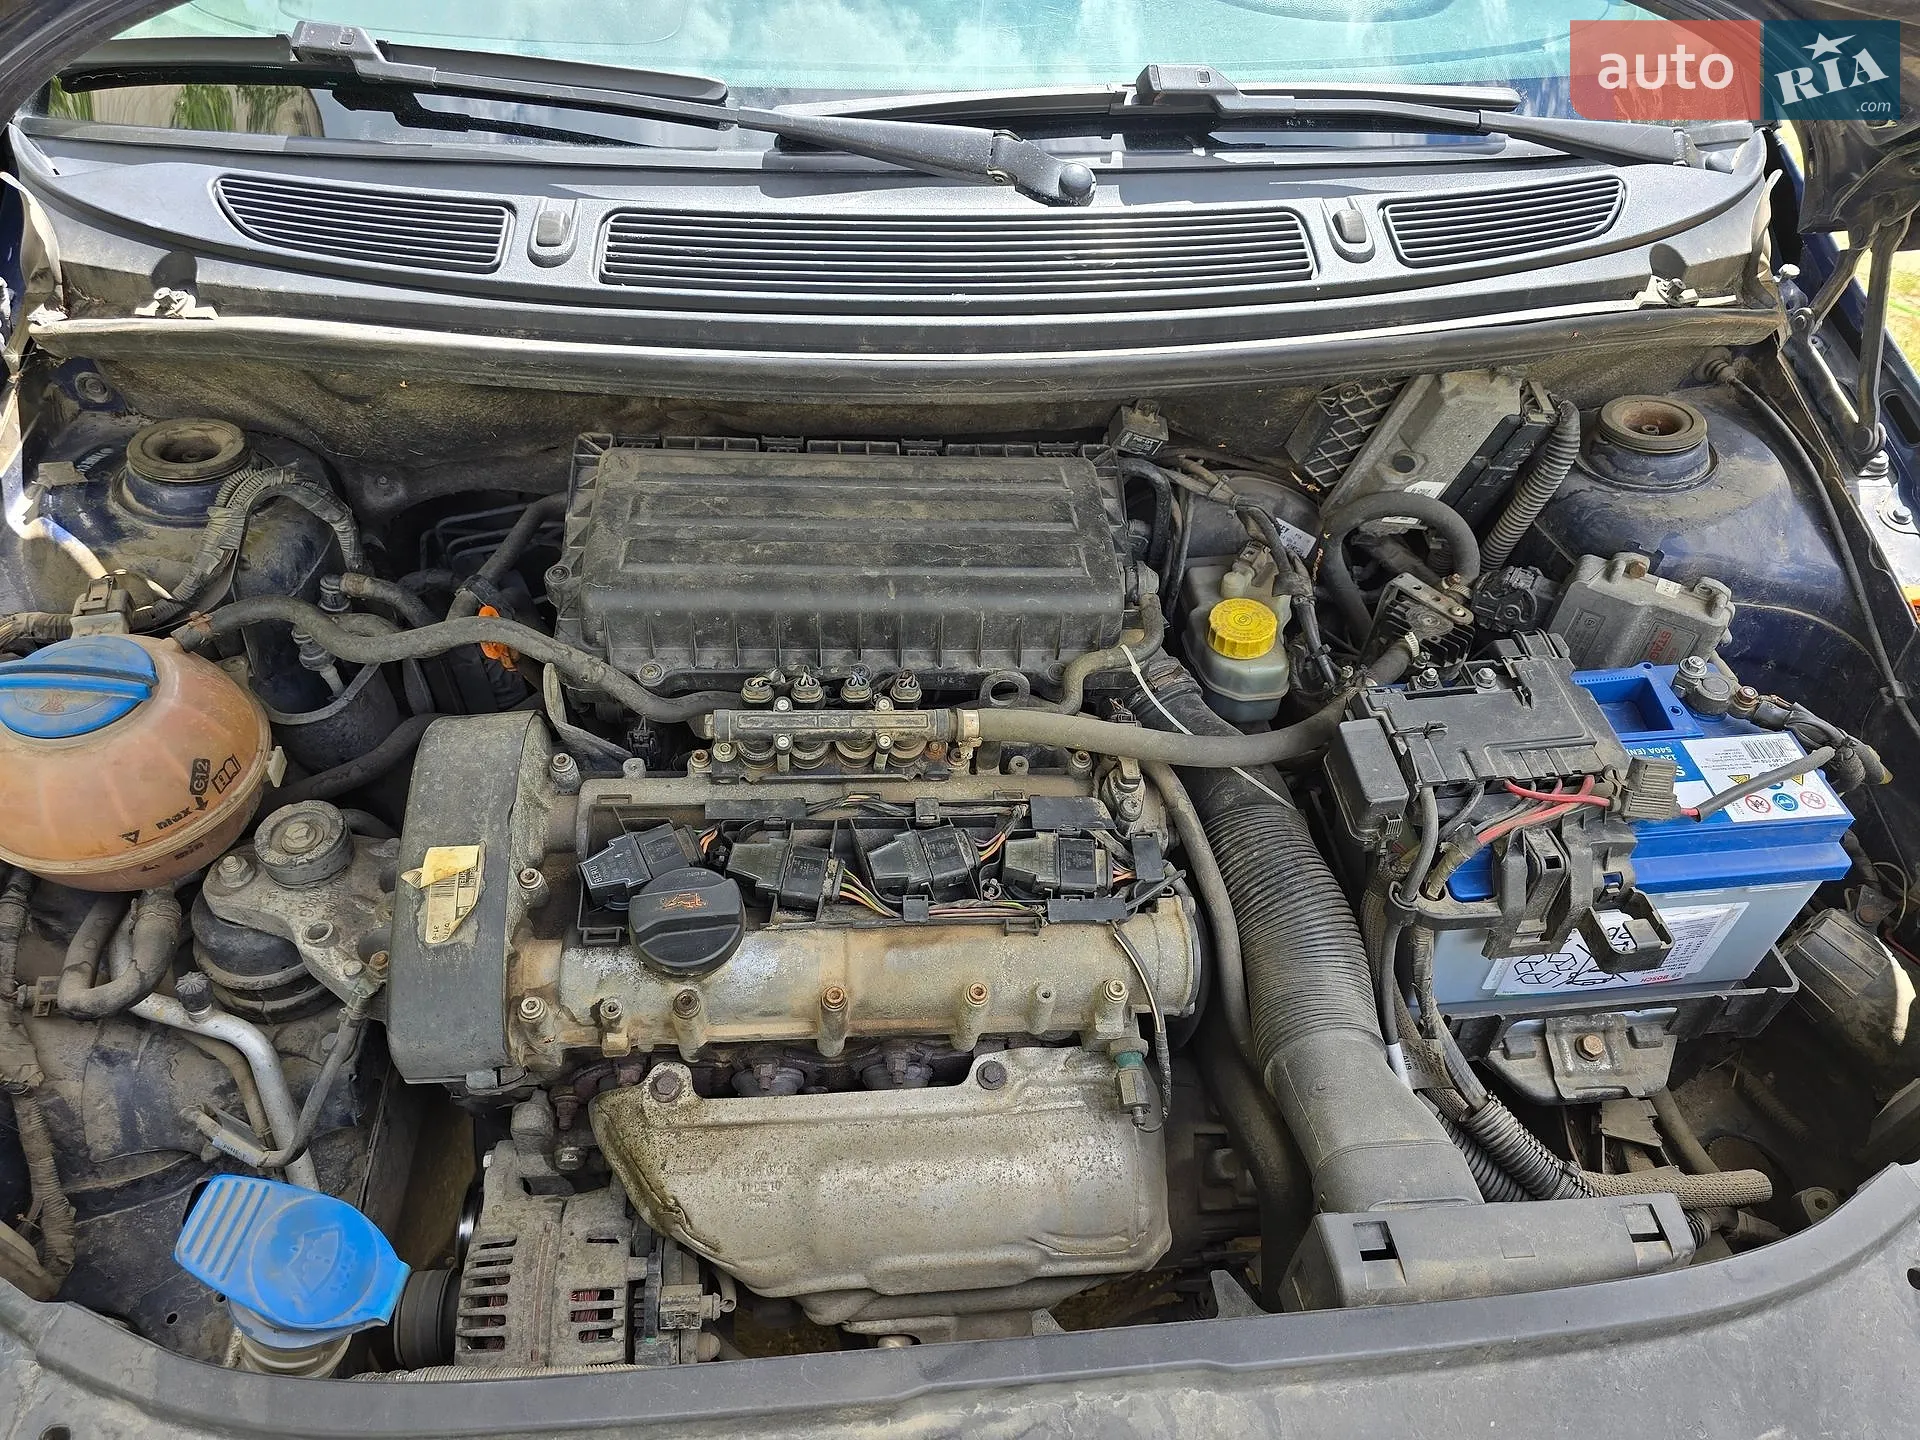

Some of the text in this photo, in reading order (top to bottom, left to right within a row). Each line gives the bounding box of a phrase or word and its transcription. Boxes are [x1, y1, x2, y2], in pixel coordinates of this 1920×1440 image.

[1626, 745, 1673, 756] 540A (EN)
[193, 760, 208, 792] G12
[156, 806, 193, 830] max
[590, 864, 603, 884] BERU
[1640, 974, 1670, 984] BOSCH
